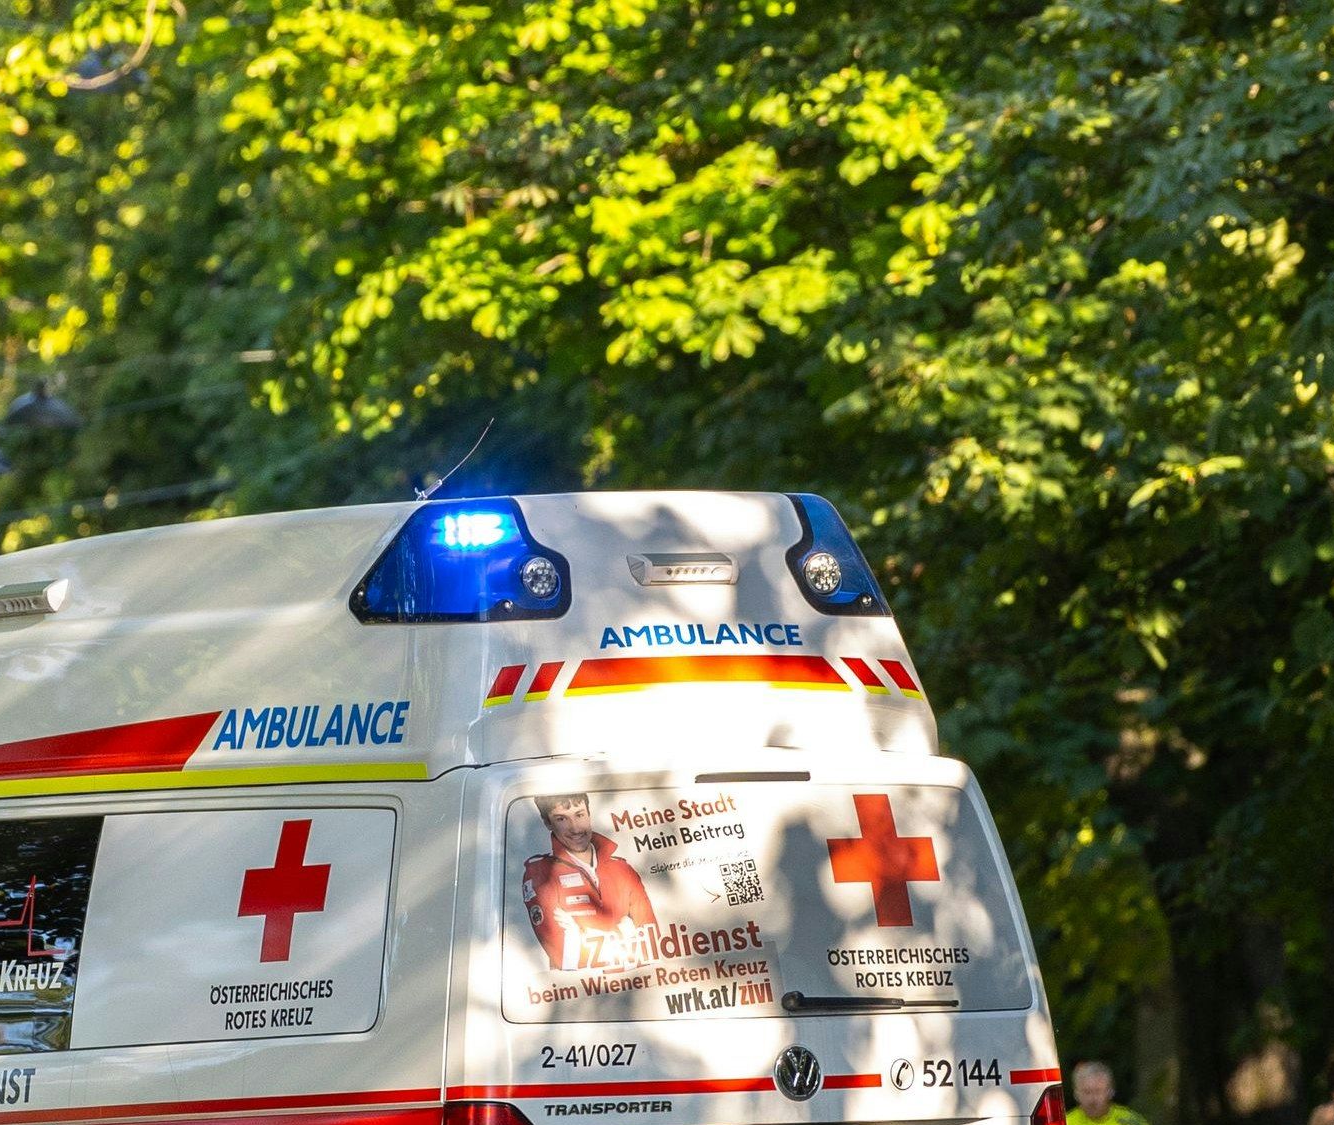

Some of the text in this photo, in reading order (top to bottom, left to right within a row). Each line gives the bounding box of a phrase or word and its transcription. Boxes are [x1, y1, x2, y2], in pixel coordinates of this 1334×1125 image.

[600, 623, 803, 649] AMBULANCE
[212, 701, 411, 751] AMBULANCE
[610, 793, 737, 833] Meine Stadt
[633, 823, 745, 853] Mein Beitrag
[826, 947, 970, 966] ÖSTERREICHISCHES
[210, 979, 334, 1005] ÖSTERREICHISCHES
[527, 959, 769, 1005] beim Wiener Roten Kreuz
[855, 970, 954, 988] ROTES KREUZ
[665, 979, 774, 1016] wrk.at/zivi
[225, 1006, 314, 1030] ROTES KREUZ
[541, 1043, 637, 1069] 2-41/027
[923, 1058, 1002, 1088] 52 144
[544, 1100, 673, 1116] TRANSPORTER
